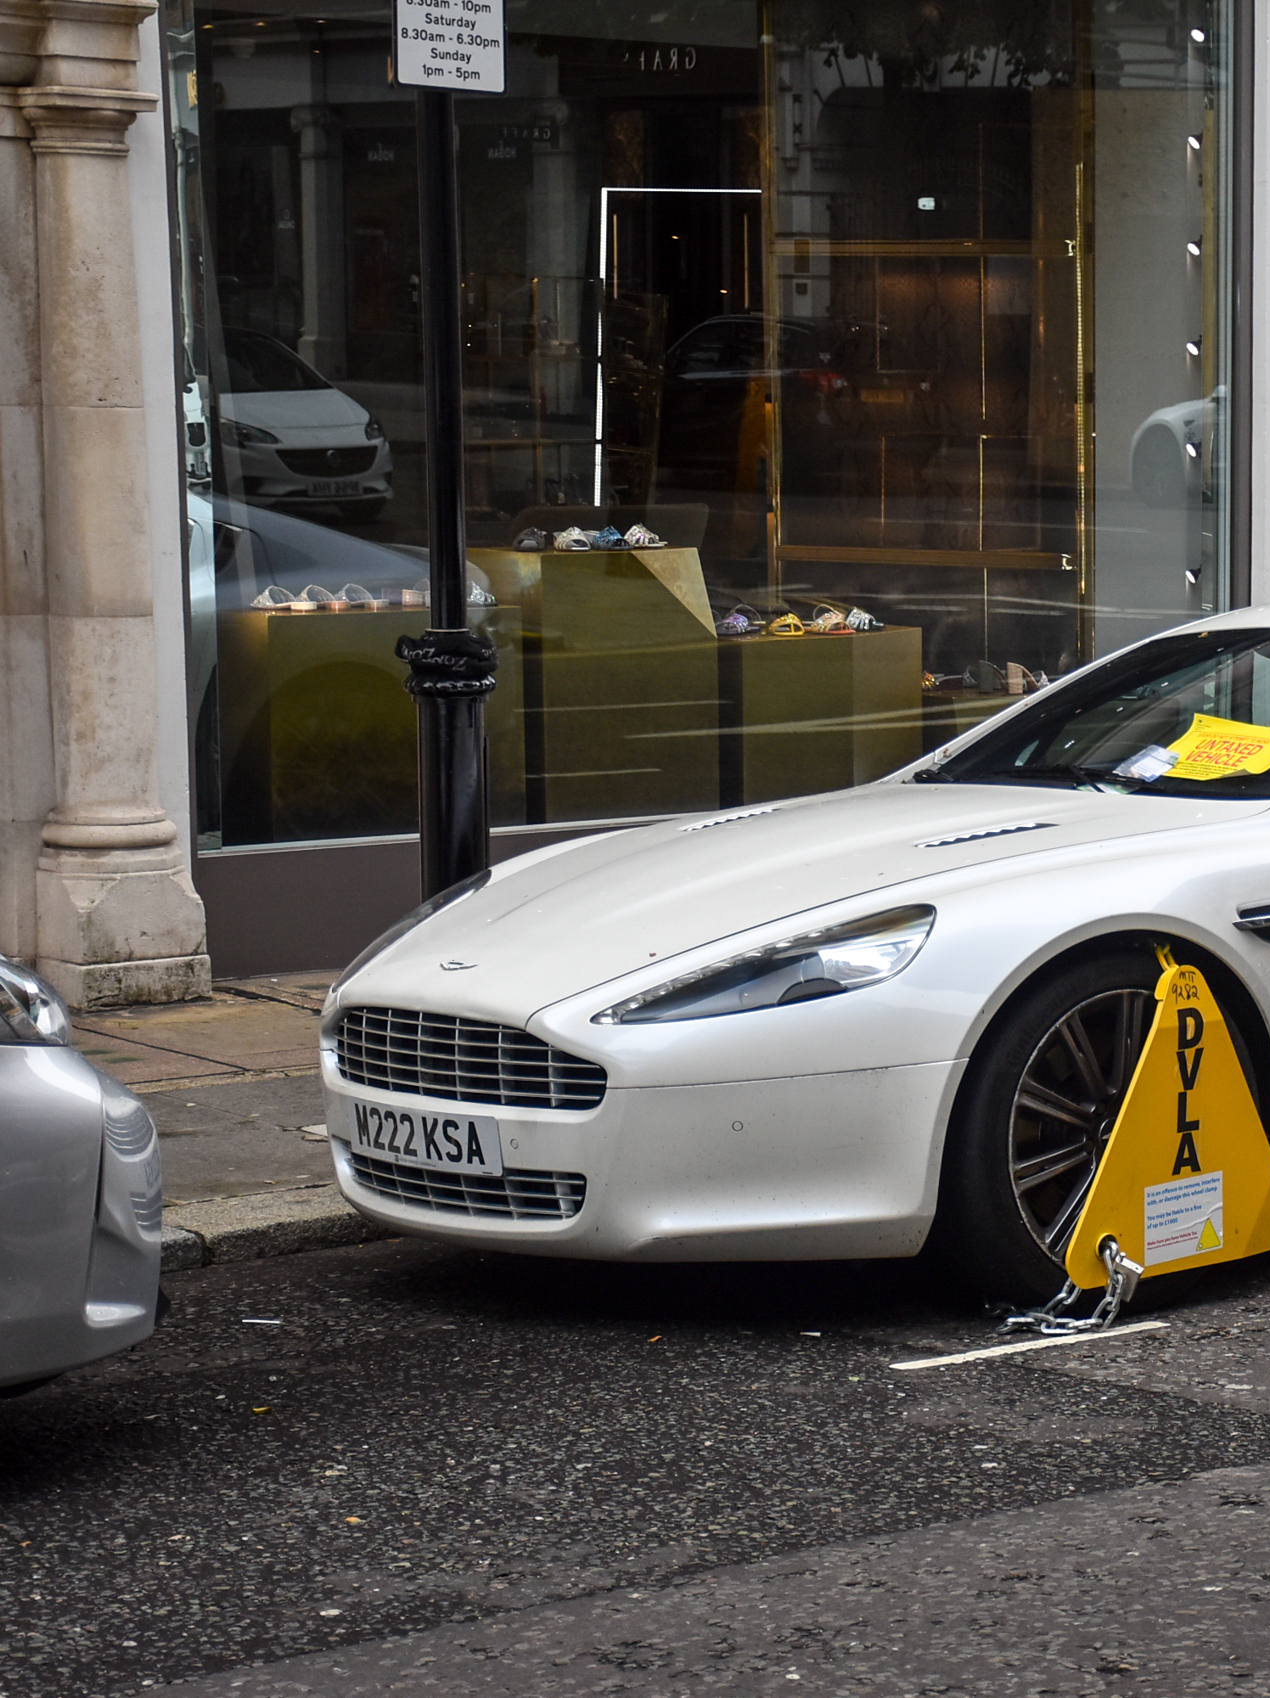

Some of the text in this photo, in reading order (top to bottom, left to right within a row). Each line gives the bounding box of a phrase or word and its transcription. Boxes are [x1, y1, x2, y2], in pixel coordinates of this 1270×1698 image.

[462, 0, 491, 14] 10pm
[425, 12, 476, 31] Saturday
[401, 27, 445, 43] 8.30am
[456, 33, 500, 49] 6.30pm
[430, 47, 472, 64] Sunday
[422, 64, 444, 78] 1pm
[455, 67, 480, 81] 5pm
[1195, 739, 1263, 755] UNTAXED
[1185, 750, 1249, 768] VEHICLE
[1171, 1007, 1204, 1175] DVLA
[354, 1103, 486, 1166] M222 KSA
[1191, 1188, 1204, 1196] wheel
[1205, 1186, 1218, 1194] clamp
